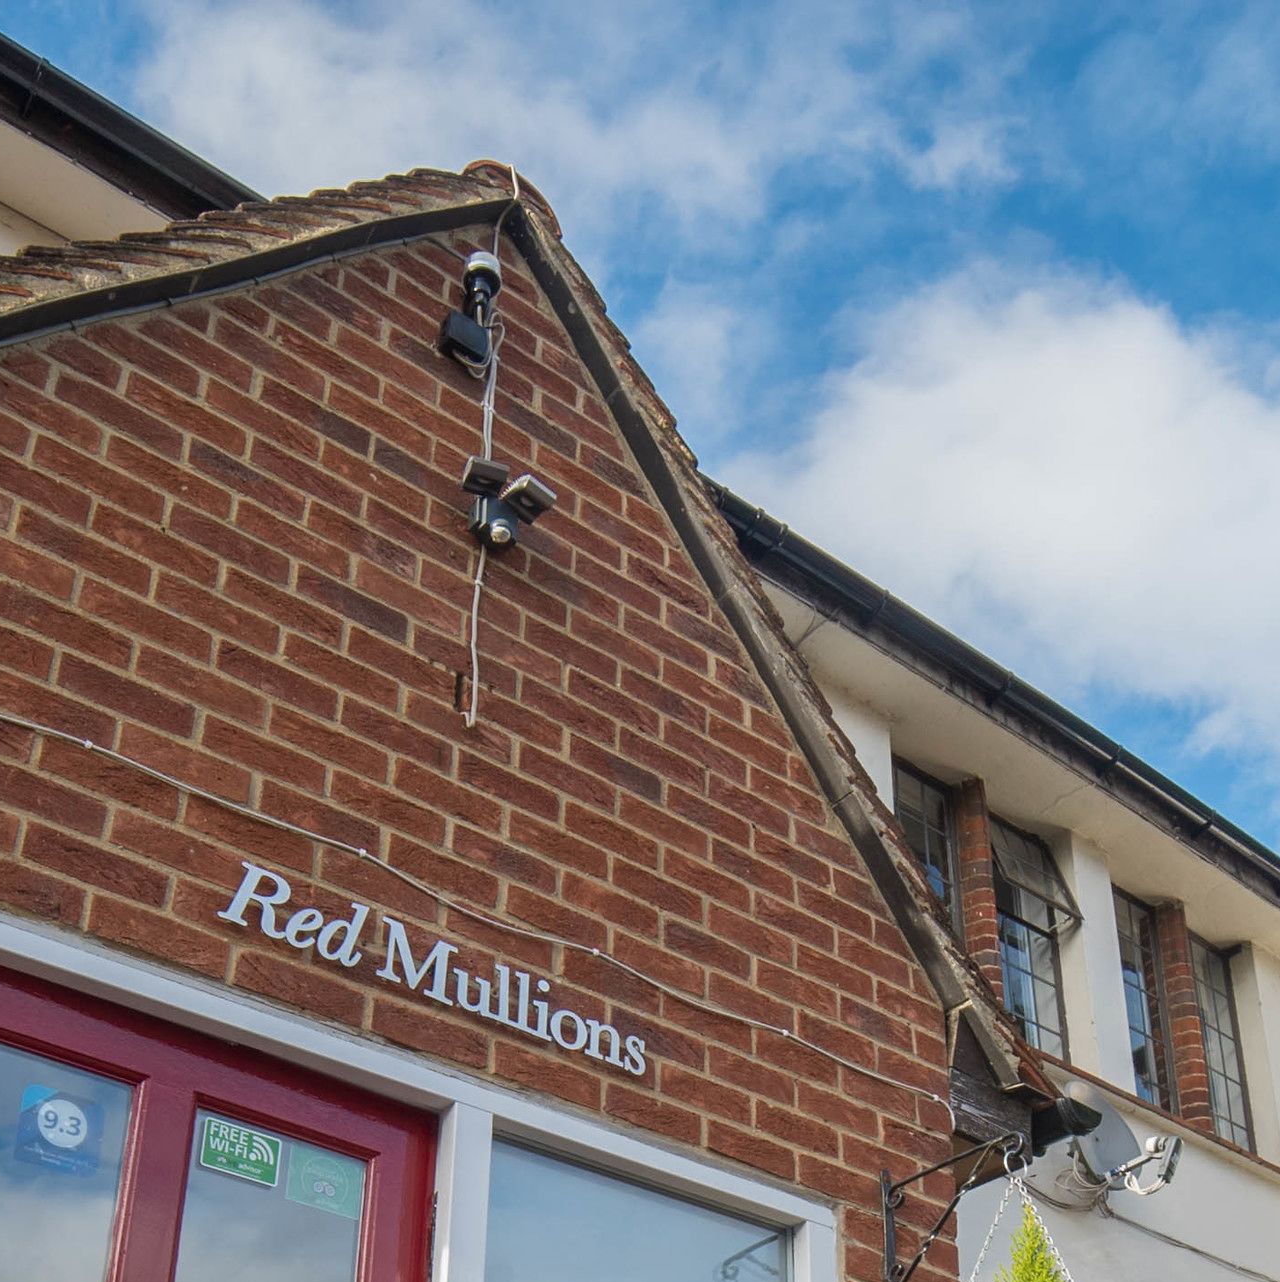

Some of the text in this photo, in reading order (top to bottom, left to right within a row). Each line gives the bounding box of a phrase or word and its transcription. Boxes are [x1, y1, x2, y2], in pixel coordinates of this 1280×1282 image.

[217, 861, 647, 1076] Red Mullions
[43, 1110, 82, 1136] 9.3
[209, 1121, 250, 1146] FREE
[209, 1135, 248, 1159] WI-FI
